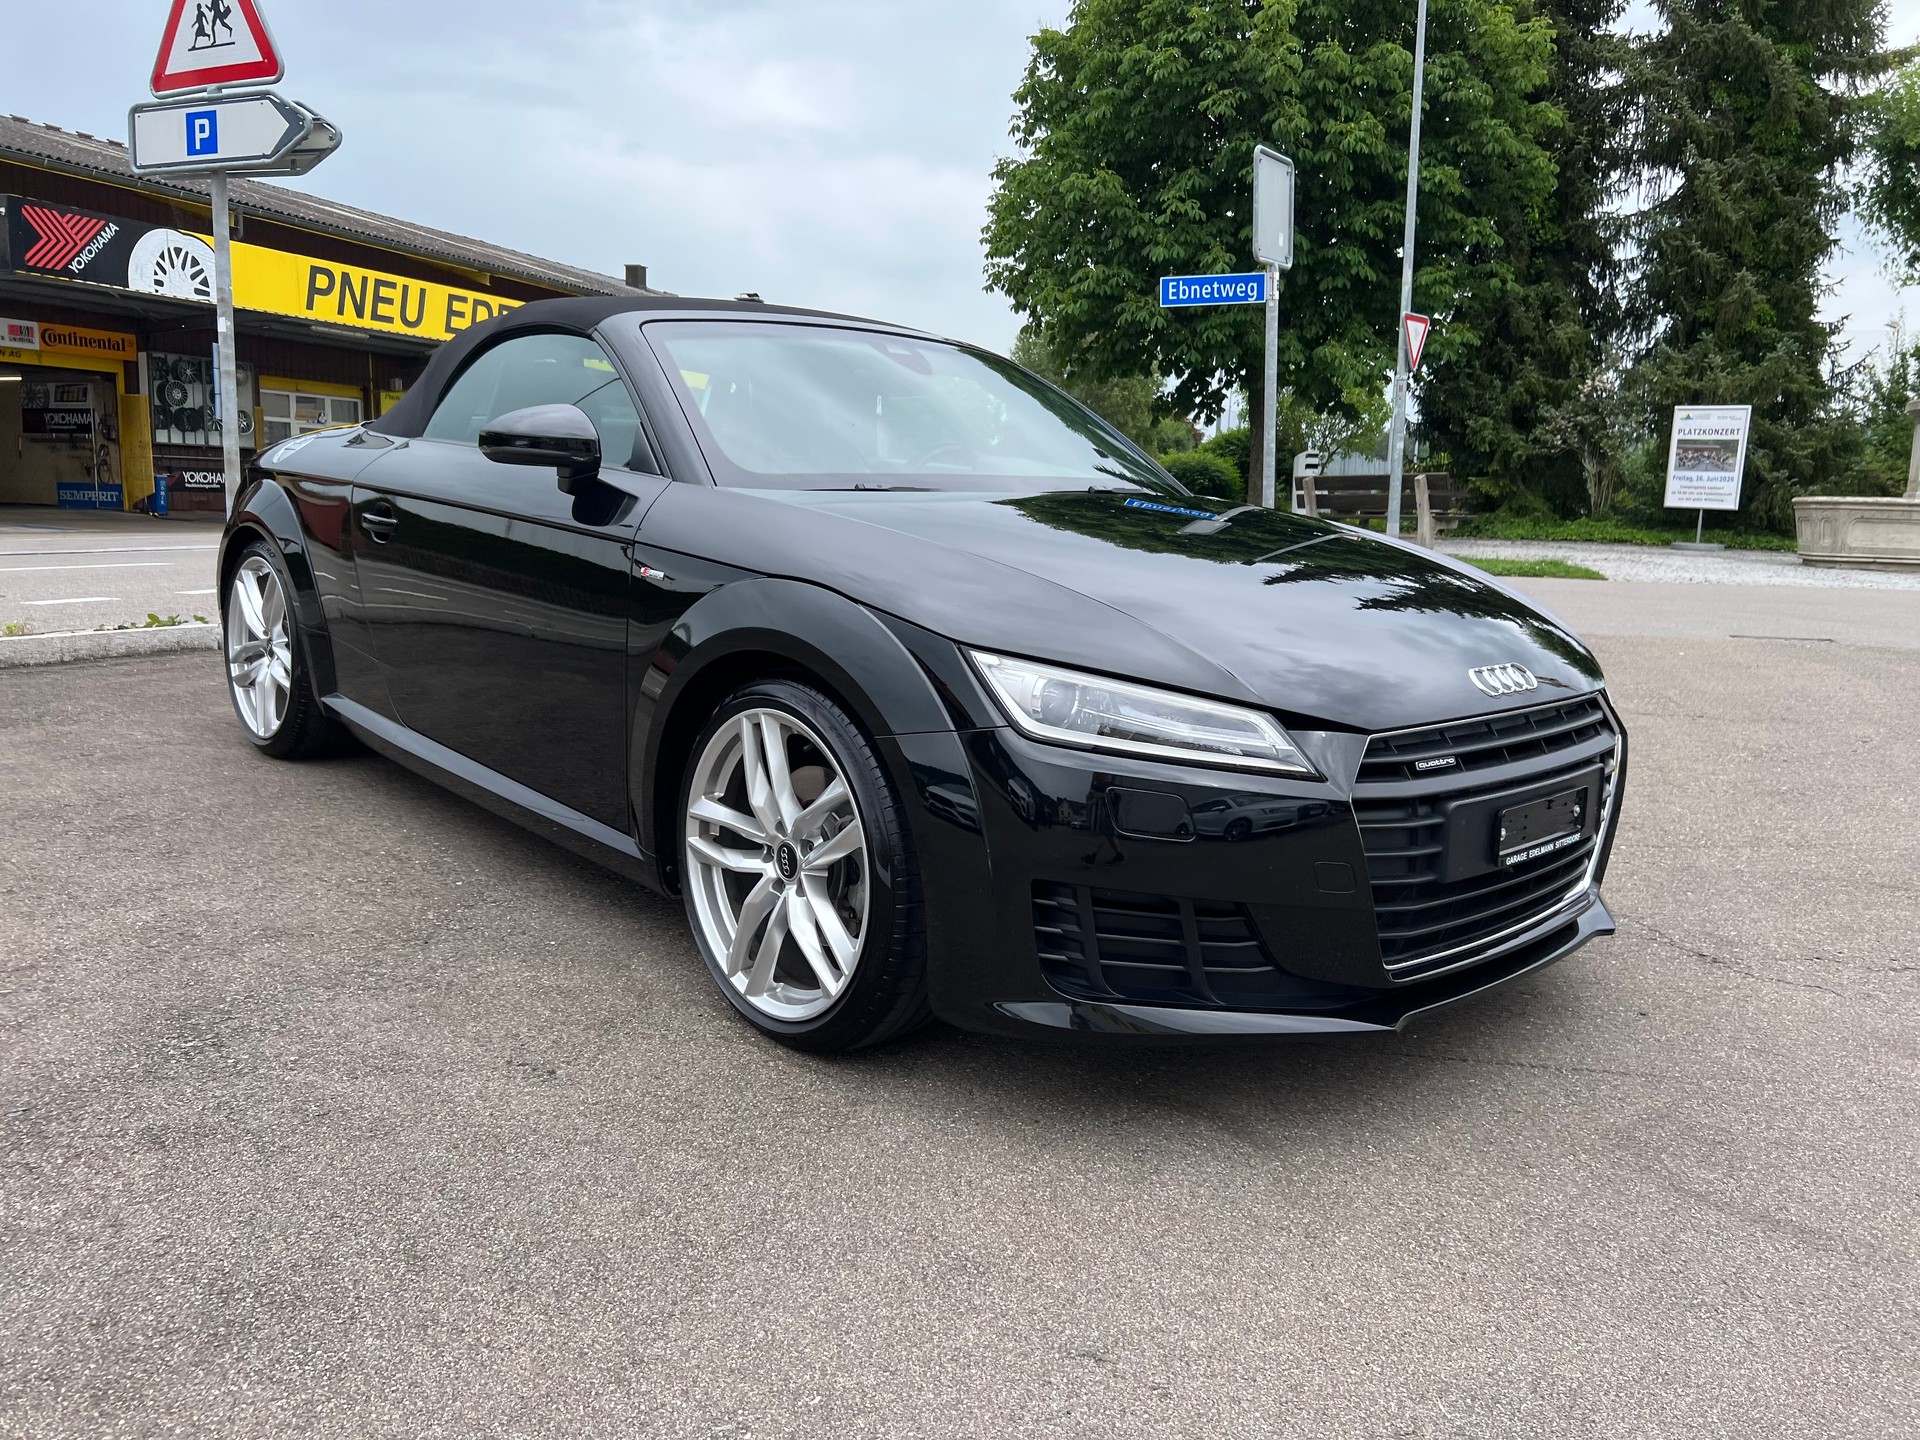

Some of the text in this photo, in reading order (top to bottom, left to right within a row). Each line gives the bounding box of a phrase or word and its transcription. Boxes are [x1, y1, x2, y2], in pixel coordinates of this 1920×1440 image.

[194, 119, 210, 149] P
[68, 222, 119, 274] YOKOHAMA
[306, 265, 426, 329] PNEU
[1168, 280, 1258, 301] Ebnetweg
[41, 327, 126, 352] Continental
[43, 412, 92, 424] YOKOHAMA
[1677, 428, 1741, 436] PLATZKONZERT
[1672, 474, 1694, 482] Freitag,
[1706, 475, 1719, 483] Juni
[59, 490, 119, 502] SEMPERIT
[1418, 758, 1455, 769] quattro
[1506, 832, 1581, 865] GARAGE EDELMANN SITTERDORF
